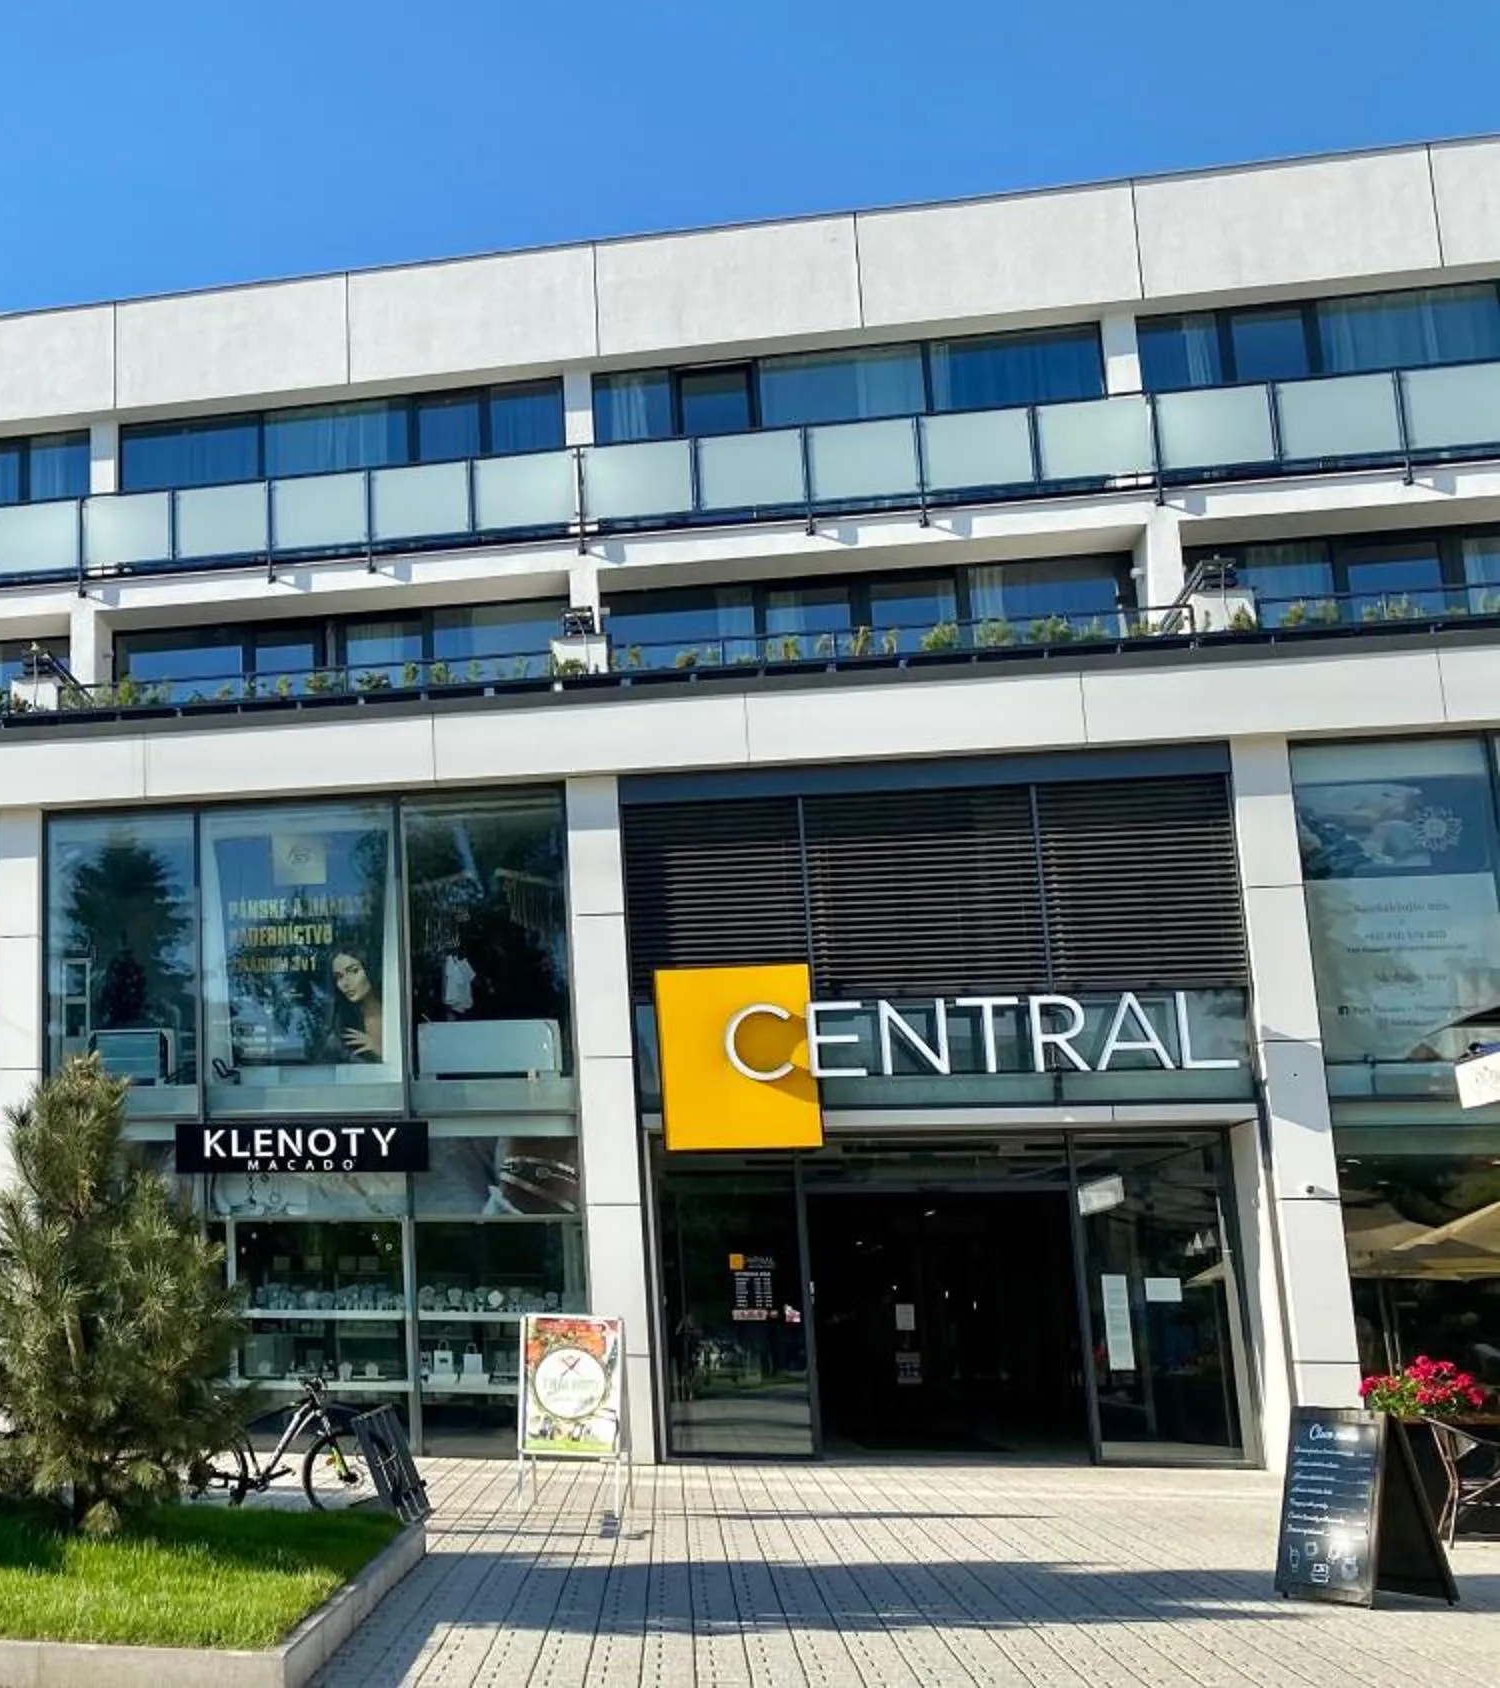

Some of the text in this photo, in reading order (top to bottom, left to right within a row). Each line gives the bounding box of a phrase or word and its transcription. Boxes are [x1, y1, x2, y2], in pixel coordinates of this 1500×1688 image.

[723, 991, 1241, 1082] CENTRAL
[203, 1126, 398, 1158] KLENOTY
[247, 1159, 355, 1172] MACADO
